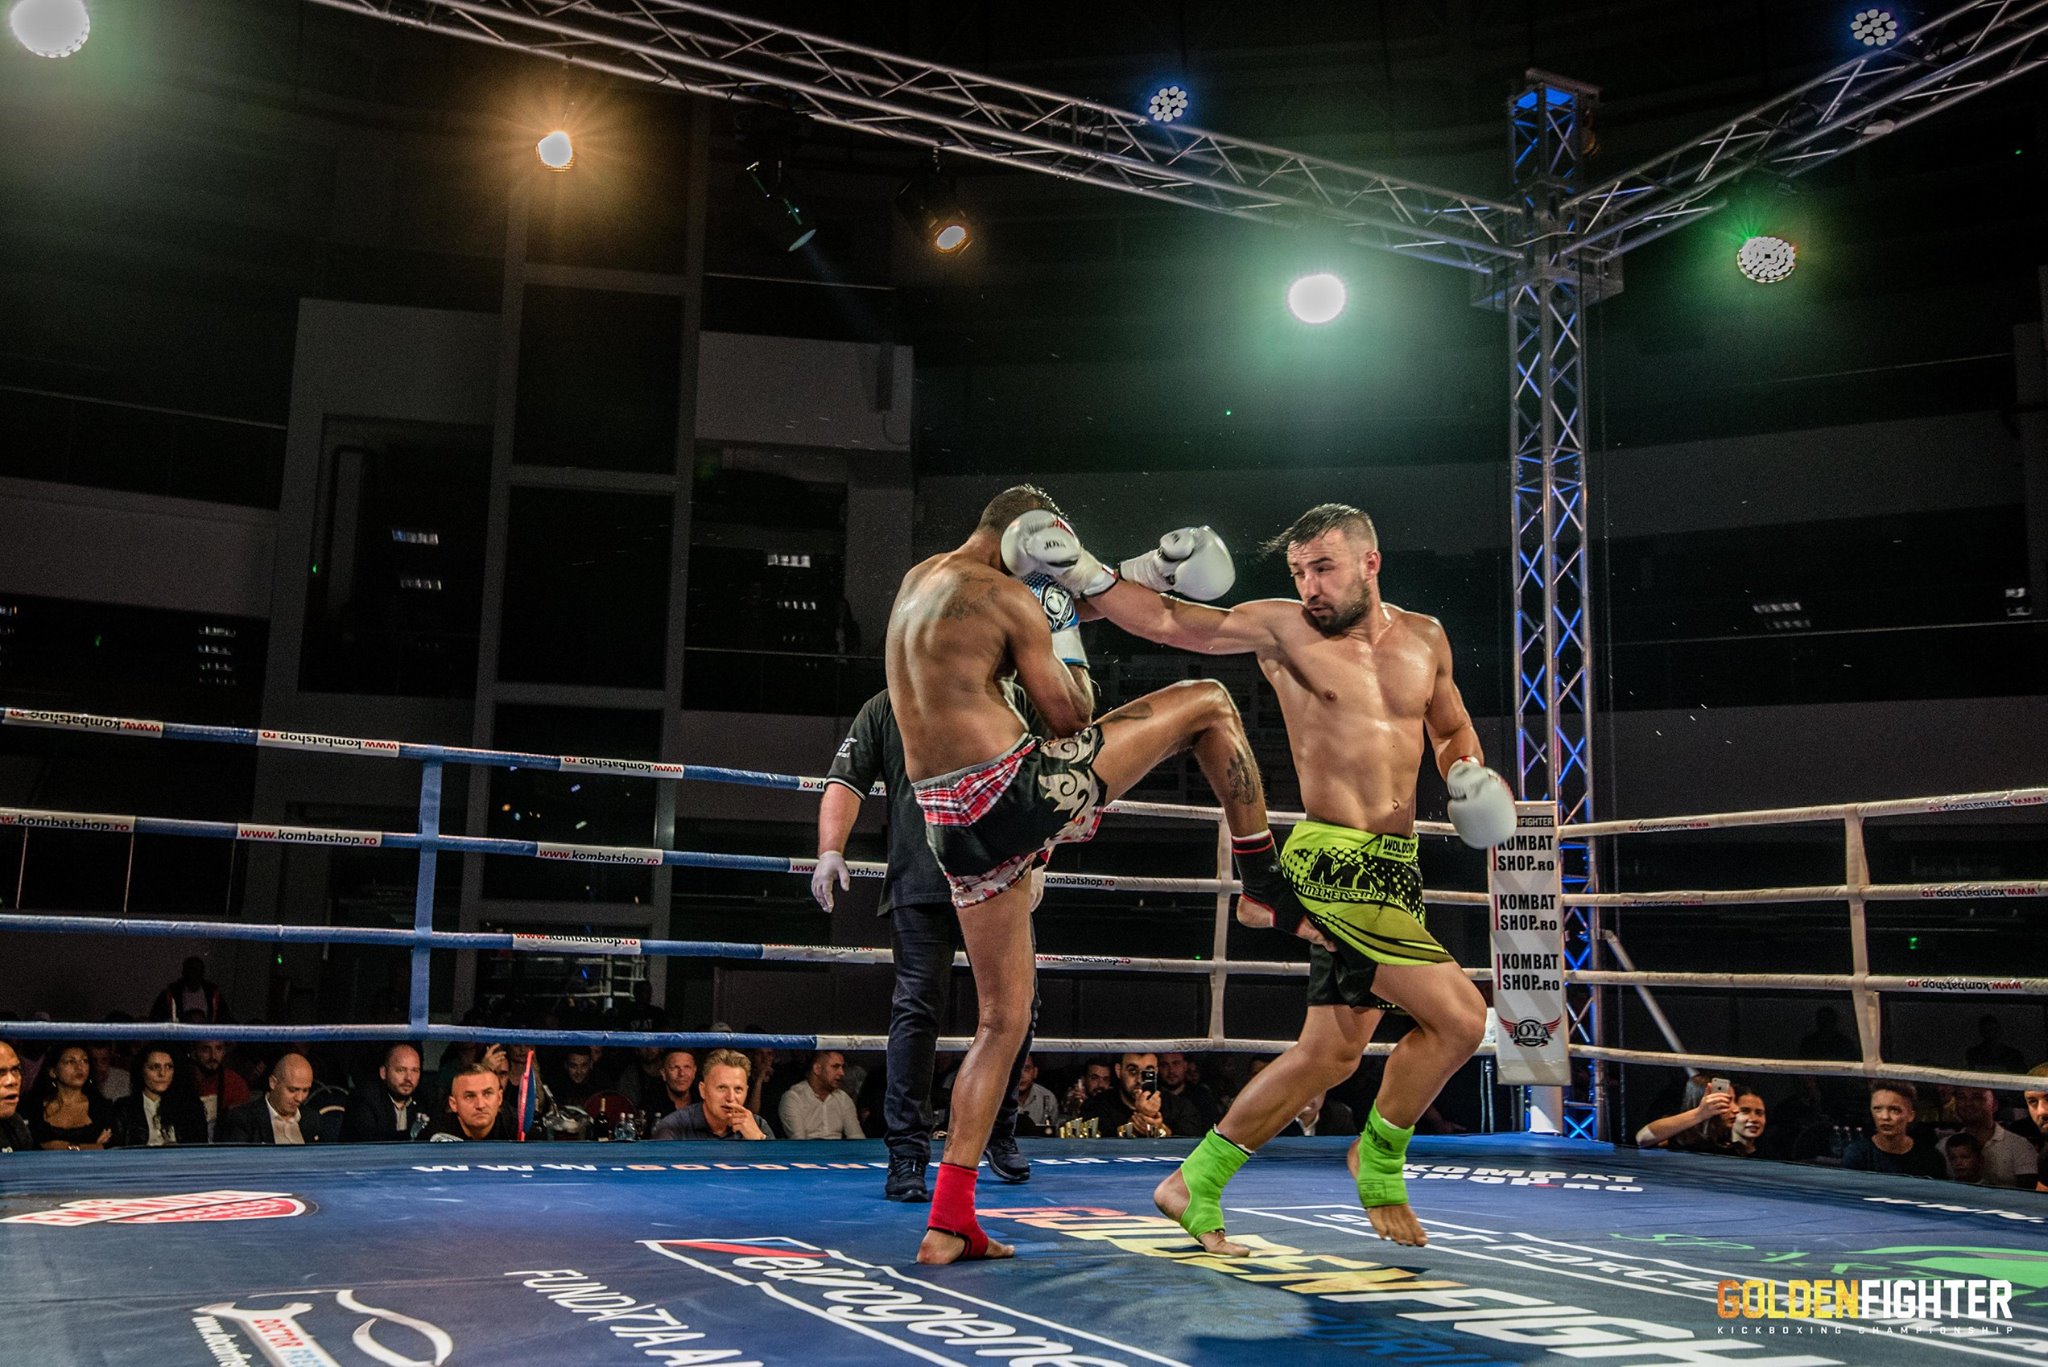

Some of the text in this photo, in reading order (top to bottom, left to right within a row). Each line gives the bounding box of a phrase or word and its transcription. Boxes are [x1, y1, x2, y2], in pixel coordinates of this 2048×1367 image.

[262, 729, 398, 750] www.kombatshop.ro
[563, 755, 683, 775] www.kombatshop.ro
[1517, 817, 1553, 826] FIGHTER
[240, 827, 378, 847] www.kombatshop.ro
[539, 849, 659, 866] www.kombatshop.ro
[1500, 894, 1556, 910] KOMBAT
[1502, 954, 1558, 969] KOMBAT
[1510, 1024, 1553, 1040] JOYA
